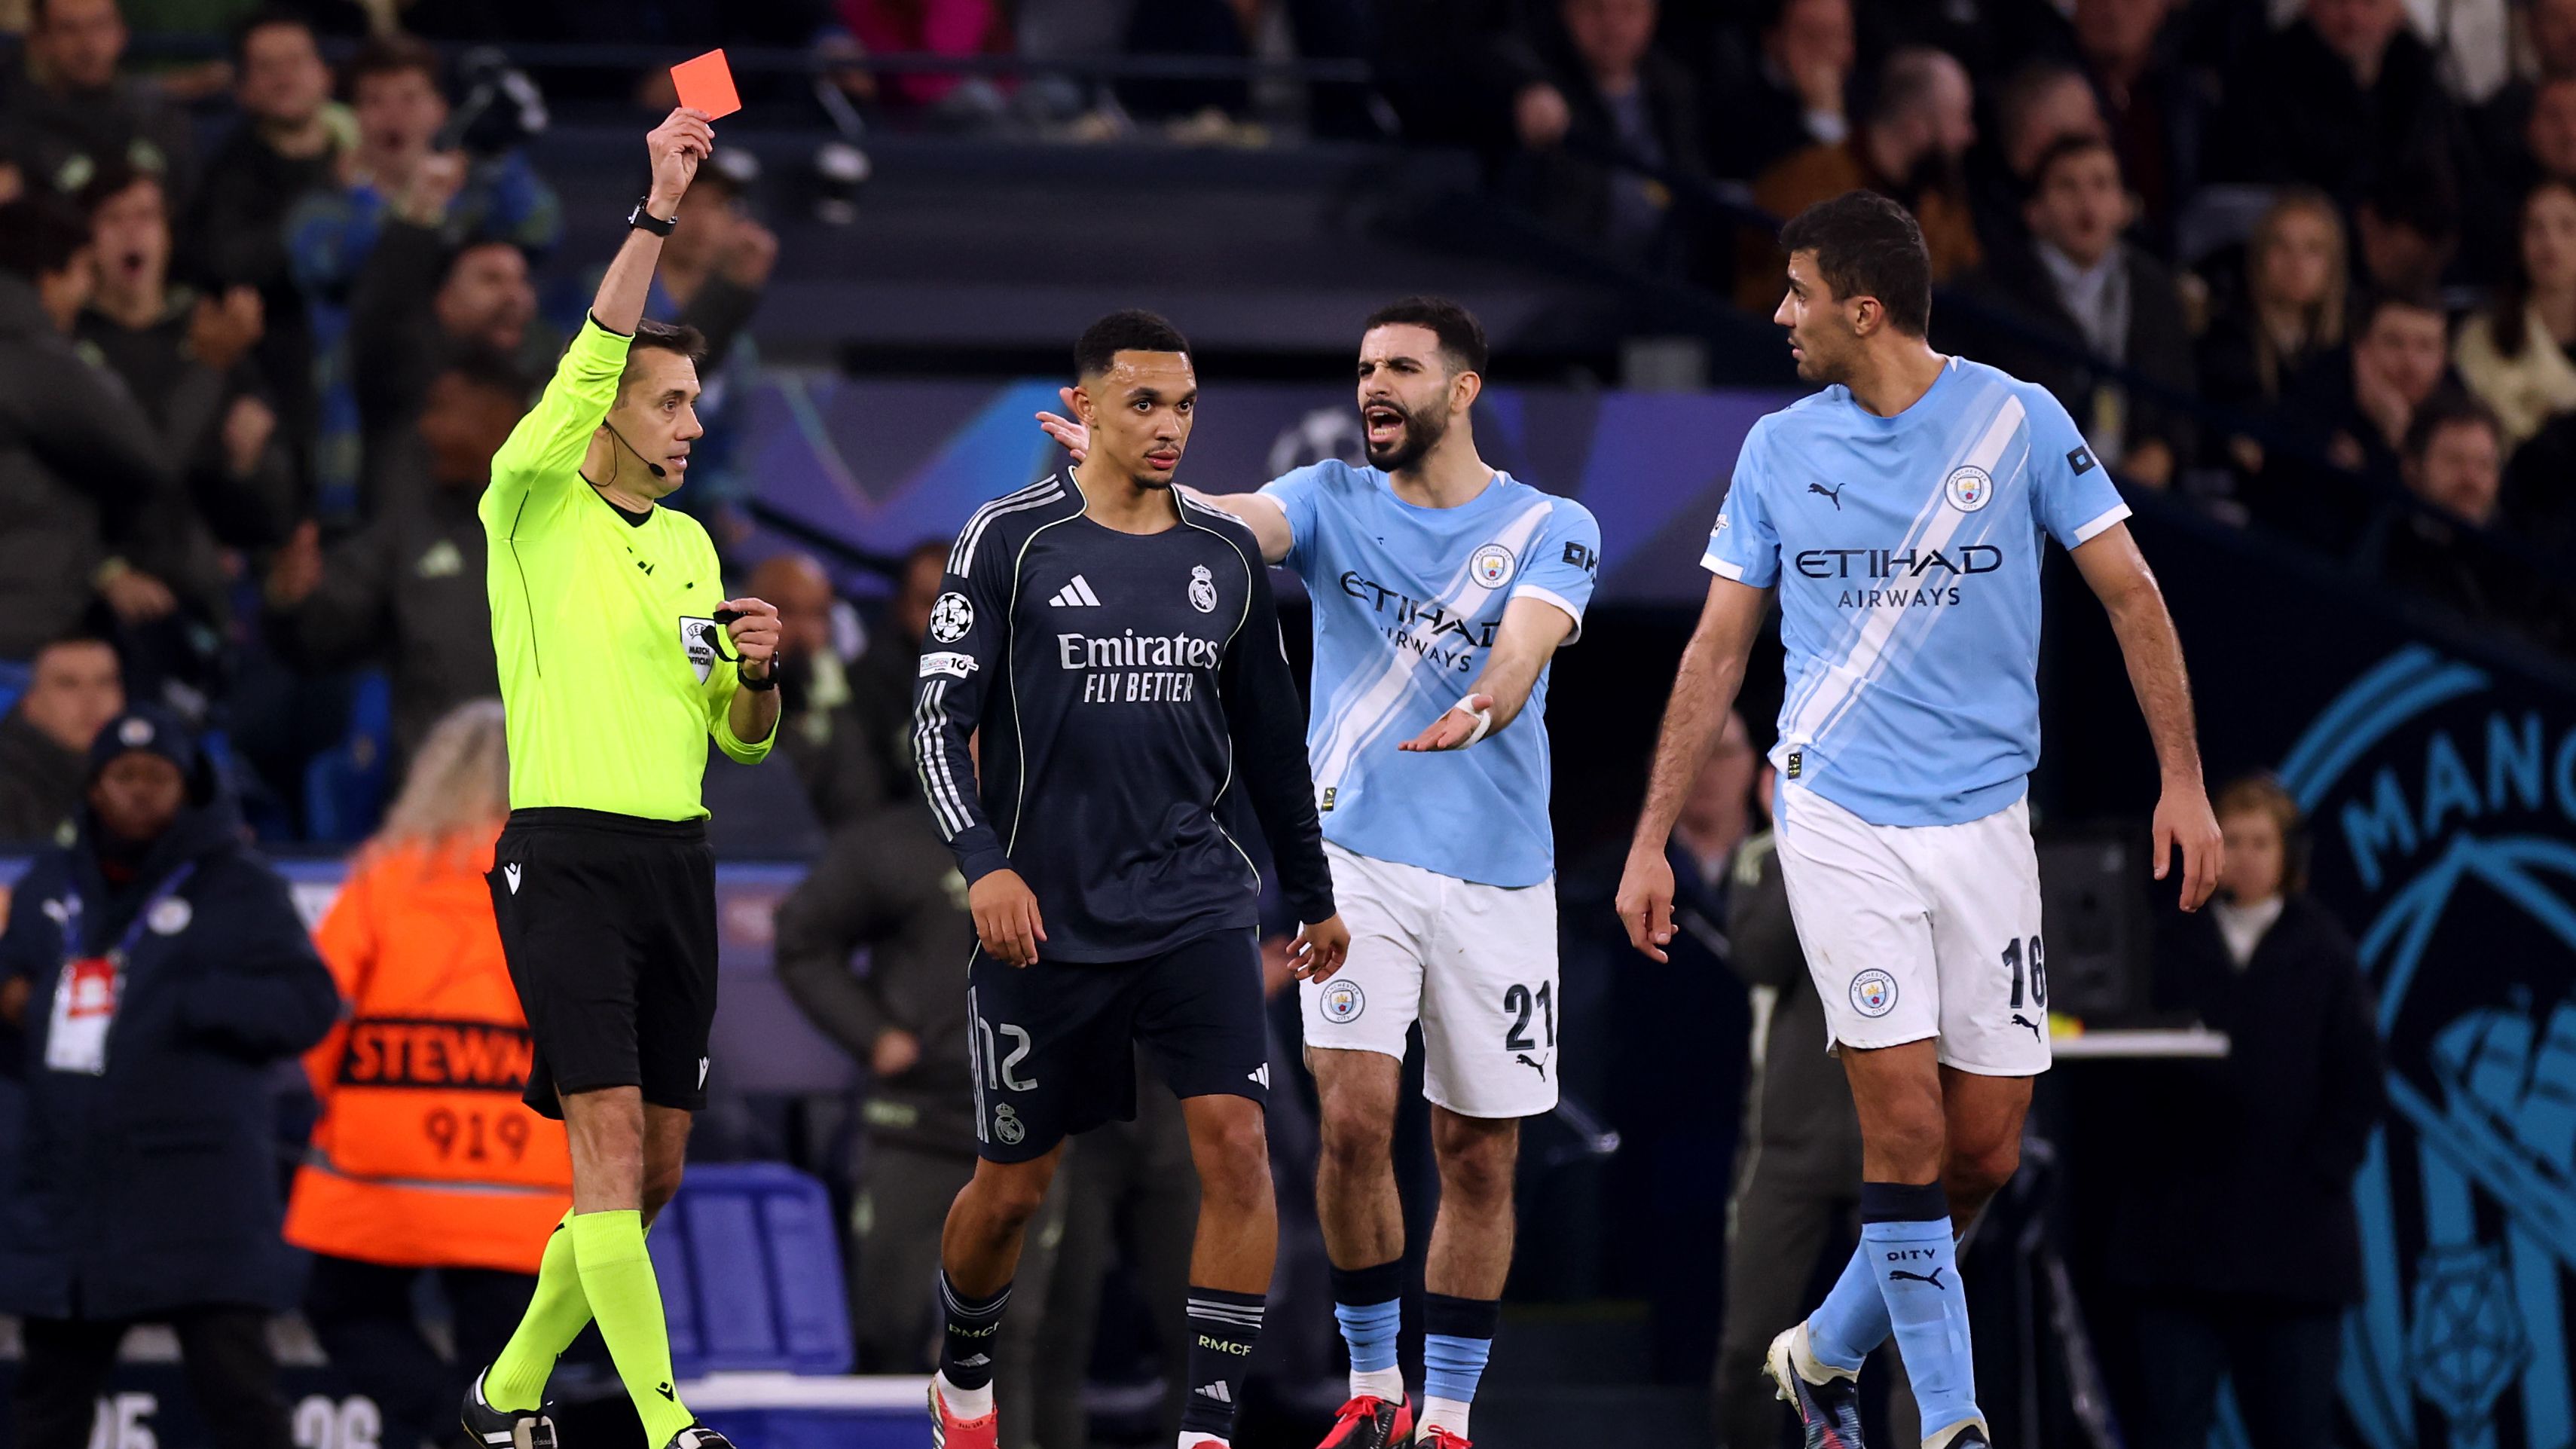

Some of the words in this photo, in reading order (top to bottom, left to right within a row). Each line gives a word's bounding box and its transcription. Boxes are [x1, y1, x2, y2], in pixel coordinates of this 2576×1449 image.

[1795, 545, 2003, 579] ETIHAD
[1838, 587, 1960, 608] AIRWAYS
[687, 625, 705, 637] UEF
[1056, 628, 1218, 670] Emirates
[1380, 625, 1471, 672] IRWAYS
[689, 646, 710, 655] MATCH
[689, 656, 710, 665] FFICIAL
[1083, 674, 1120, 703] FLY
[1126, 672, 1193, 702] BETTER
[2001, 934, 2046, 1009] 16
[1504, 980, 1554, 1051] 21
[350, 1026, 533, 1085] STEWA
[978, 1016, 1038, 1091] 12
[424, 1108, 530, 1162] 919
[1198, 1334, 1253, 1356] RMCF
